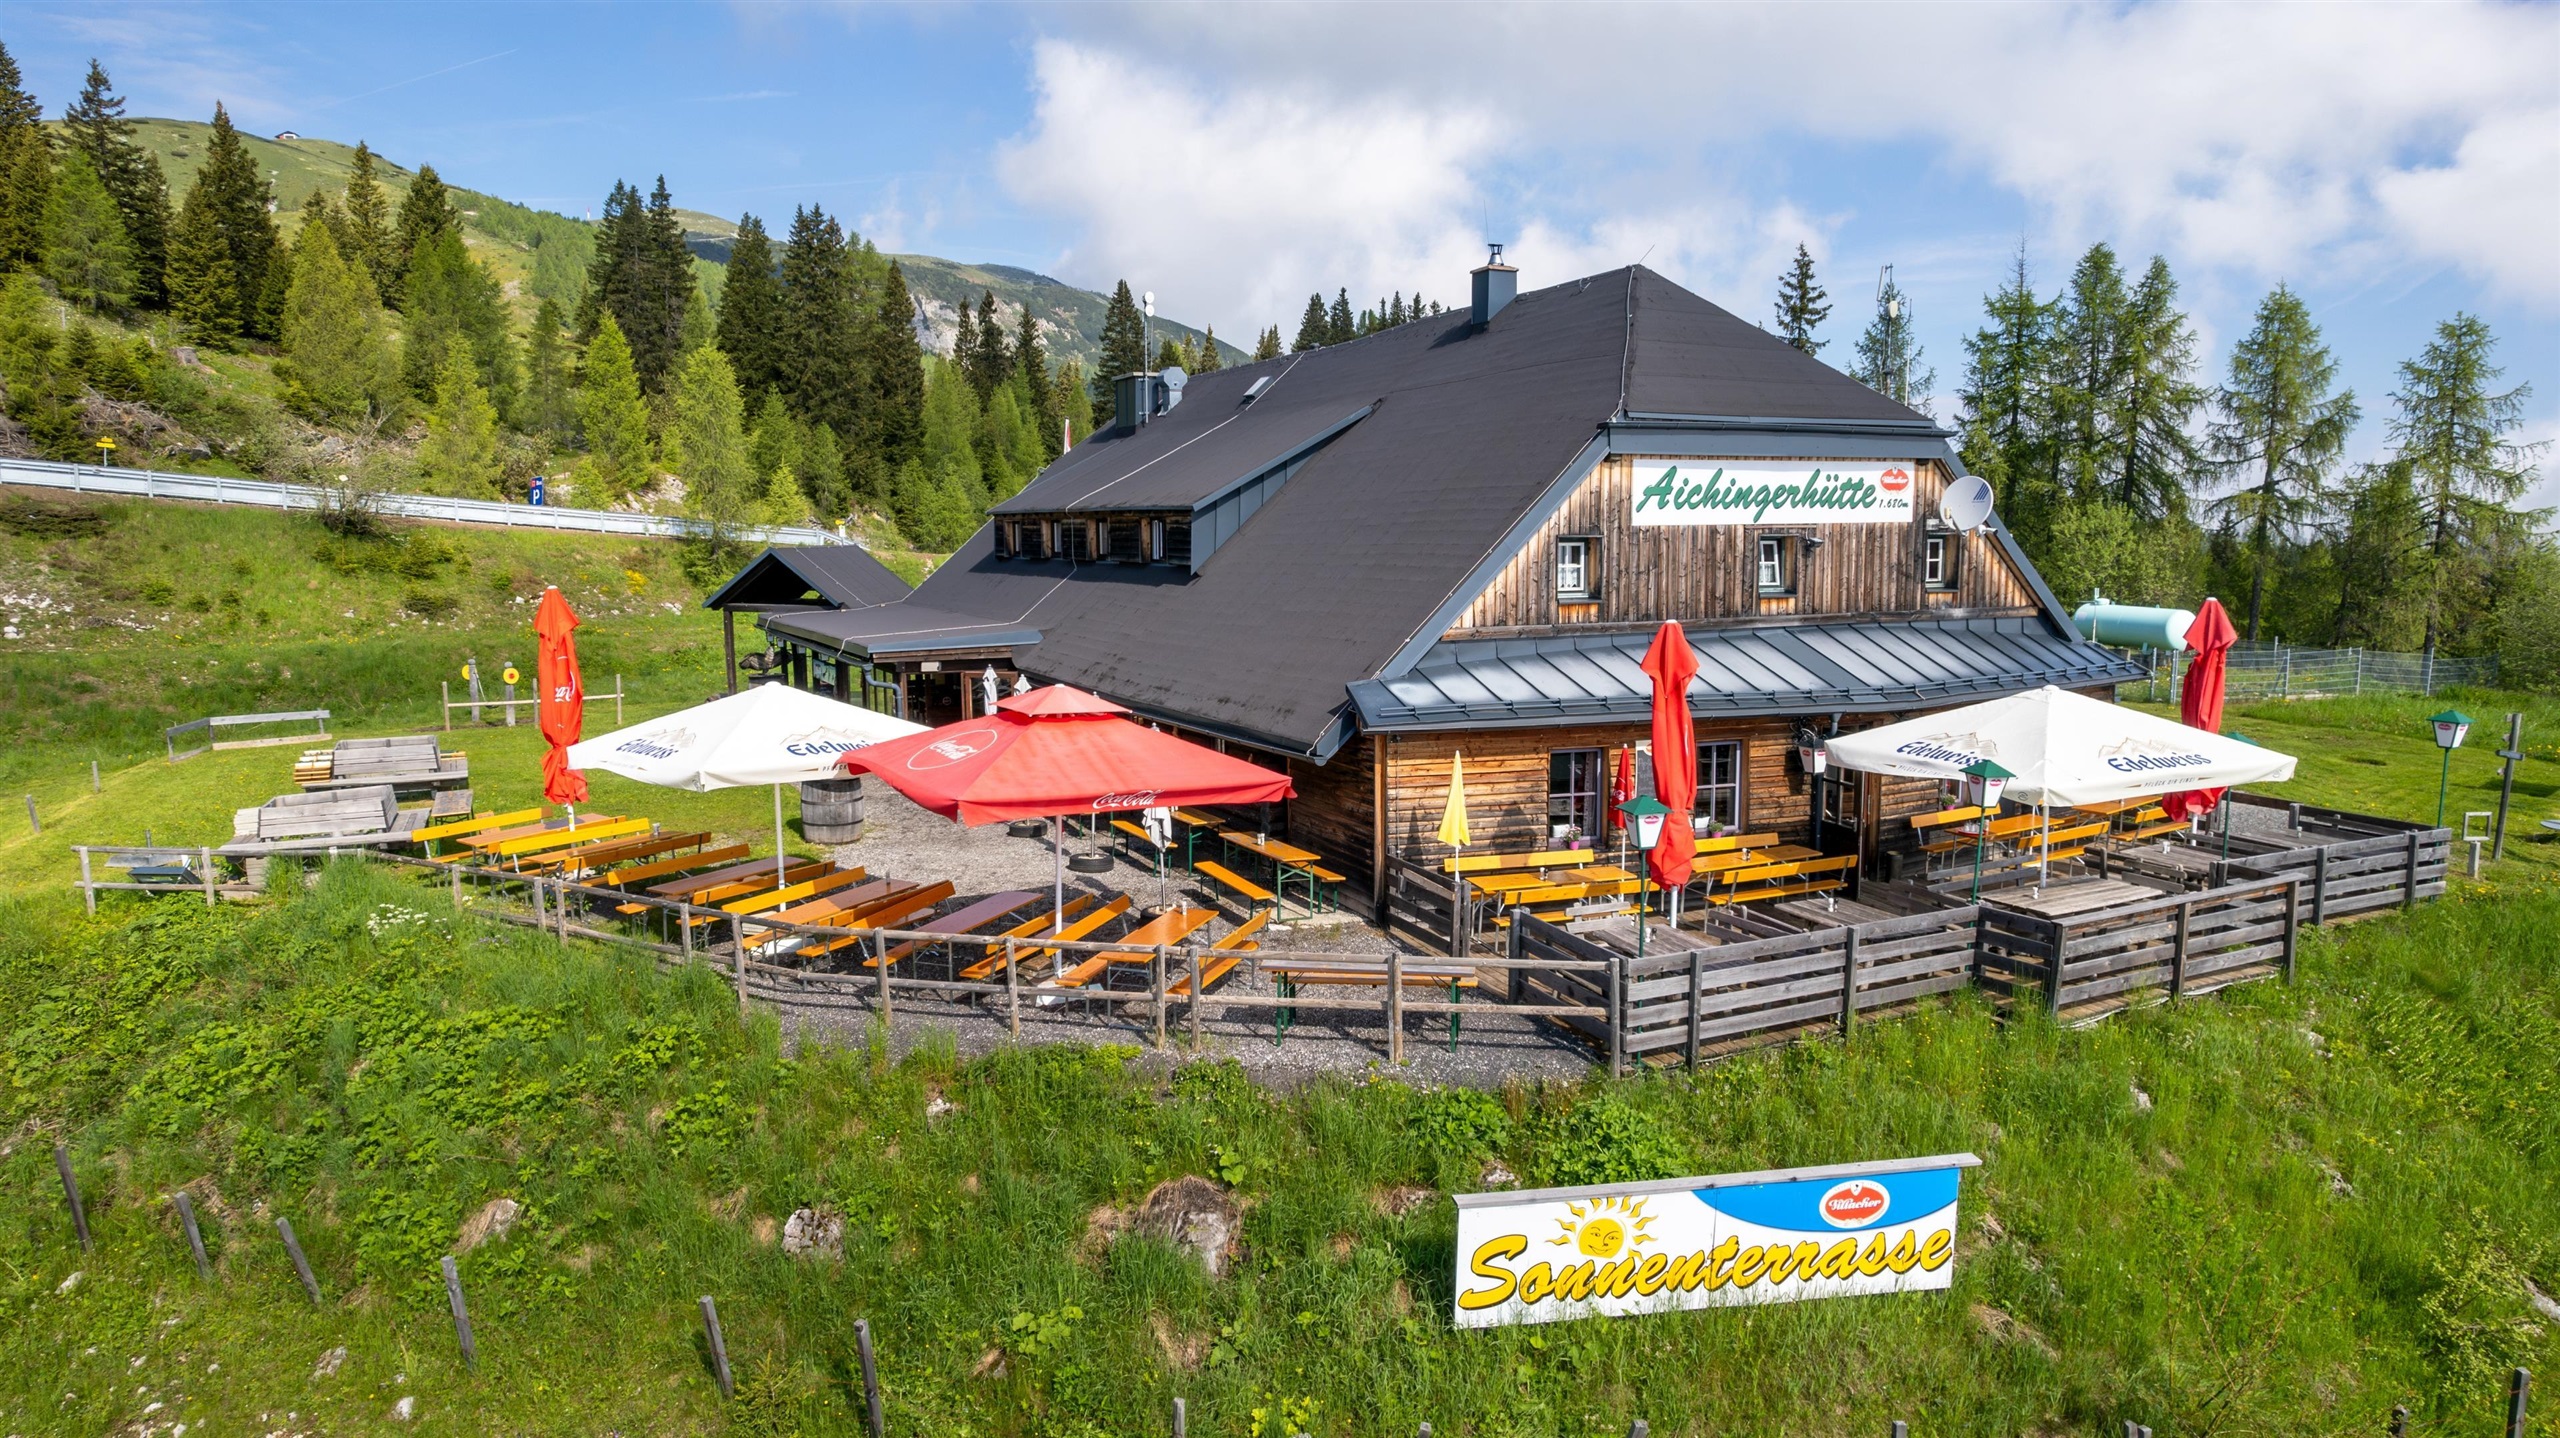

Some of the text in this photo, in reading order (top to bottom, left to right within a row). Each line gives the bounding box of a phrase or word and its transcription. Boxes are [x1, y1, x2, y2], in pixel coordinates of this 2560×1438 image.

[533, 489, 540, 505] P
[1636, 465, 1878, 523] Aichingerhütte
[2107, 752, 2212, 772] Edelweiss
[1458, 1227, 1954, 1311] Sonnenterrasse
